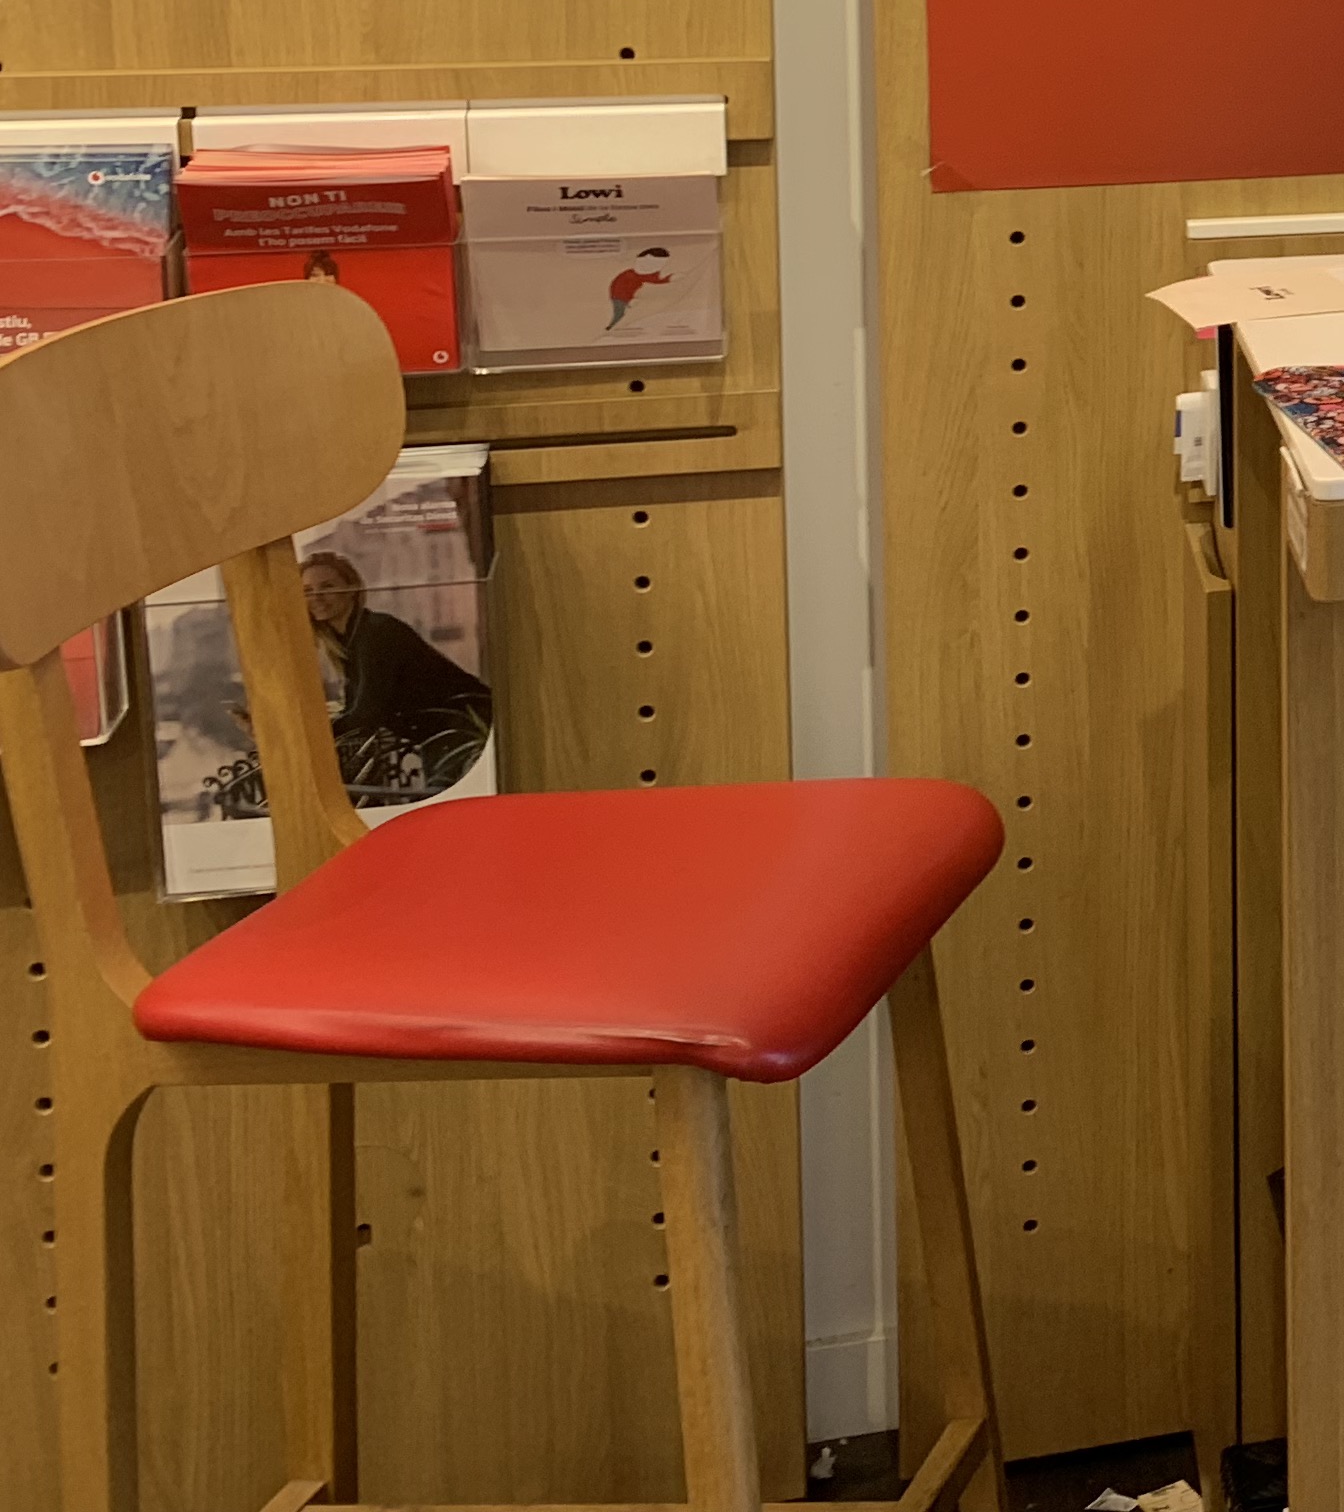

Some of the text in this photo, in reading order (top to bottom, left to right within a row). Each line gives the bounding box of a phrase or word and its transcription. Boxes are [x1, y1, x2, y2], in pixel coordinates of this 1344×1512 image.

[268, 190, 348, 209] NON TI
[559, 184, 624, 200] Lowi
